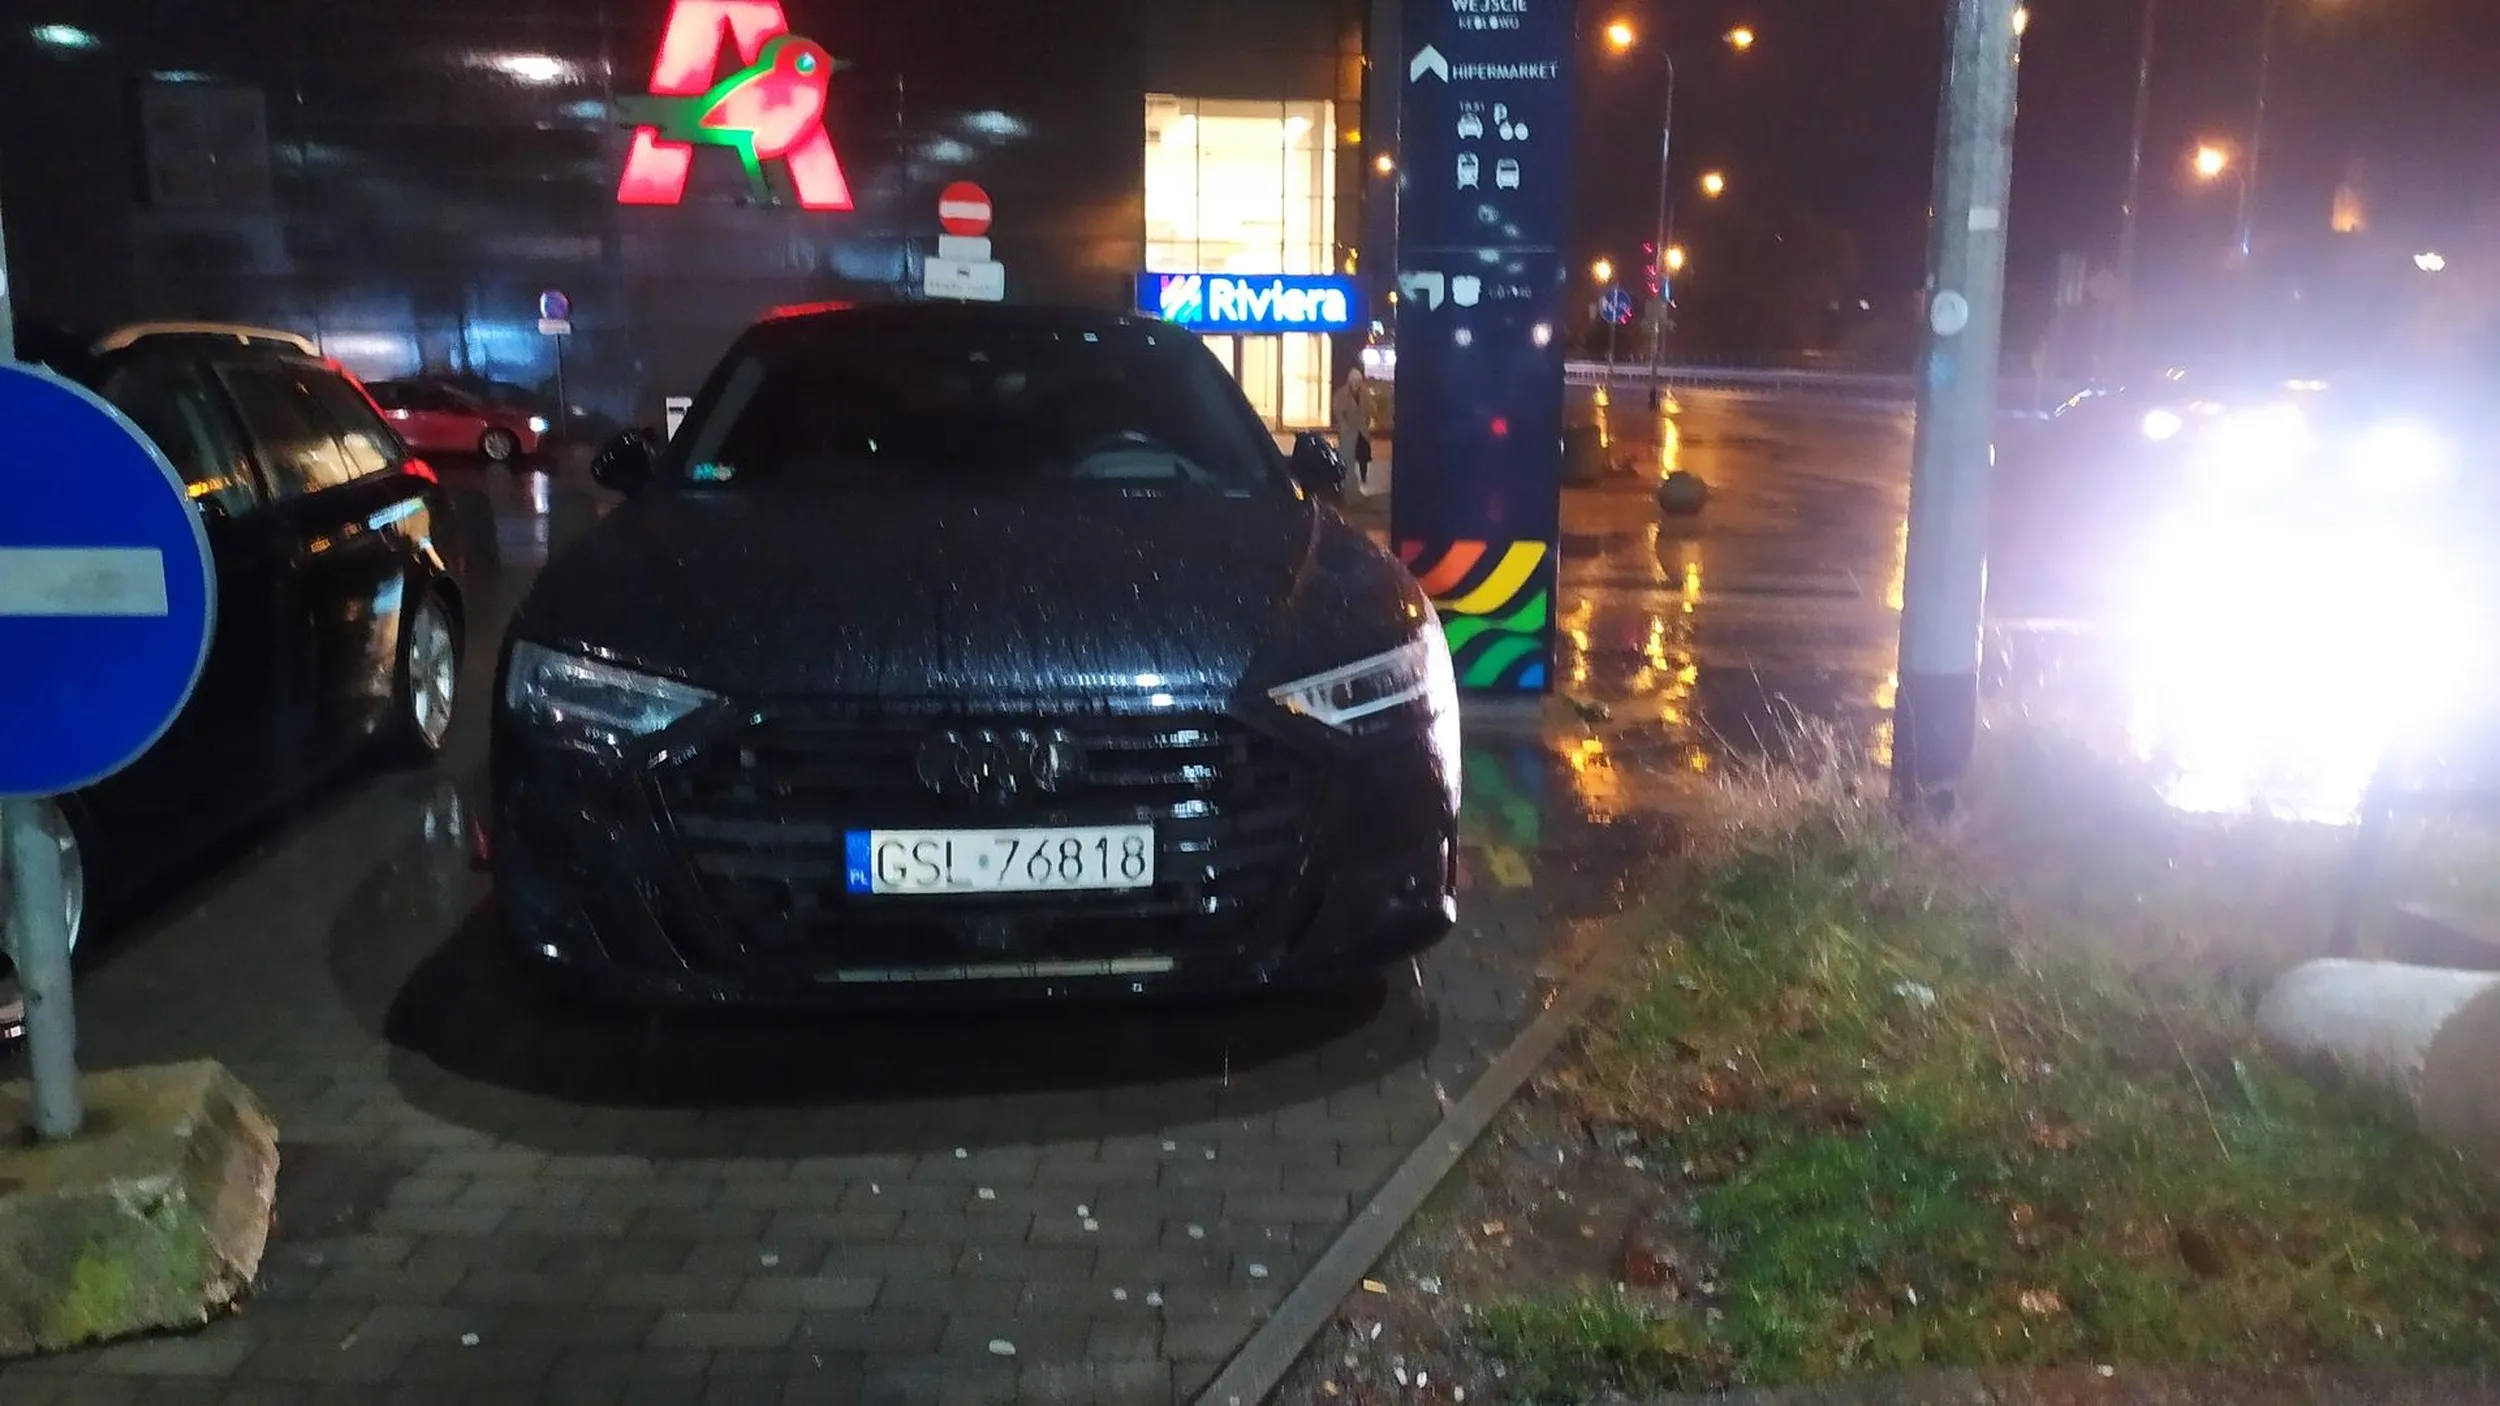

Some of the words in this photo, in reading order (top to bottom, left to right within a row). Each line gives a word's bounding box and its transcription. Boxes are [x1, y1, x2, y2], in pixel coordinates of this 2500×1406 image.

[1452, 62, 1558, 80] HIPERMARKET
[1208, 278, 1347, 323] Riviera
[877, 838, 973, 887] GSL
[994, 835, 1147, 882] 76818
[849, 868, 869, 886] PL
